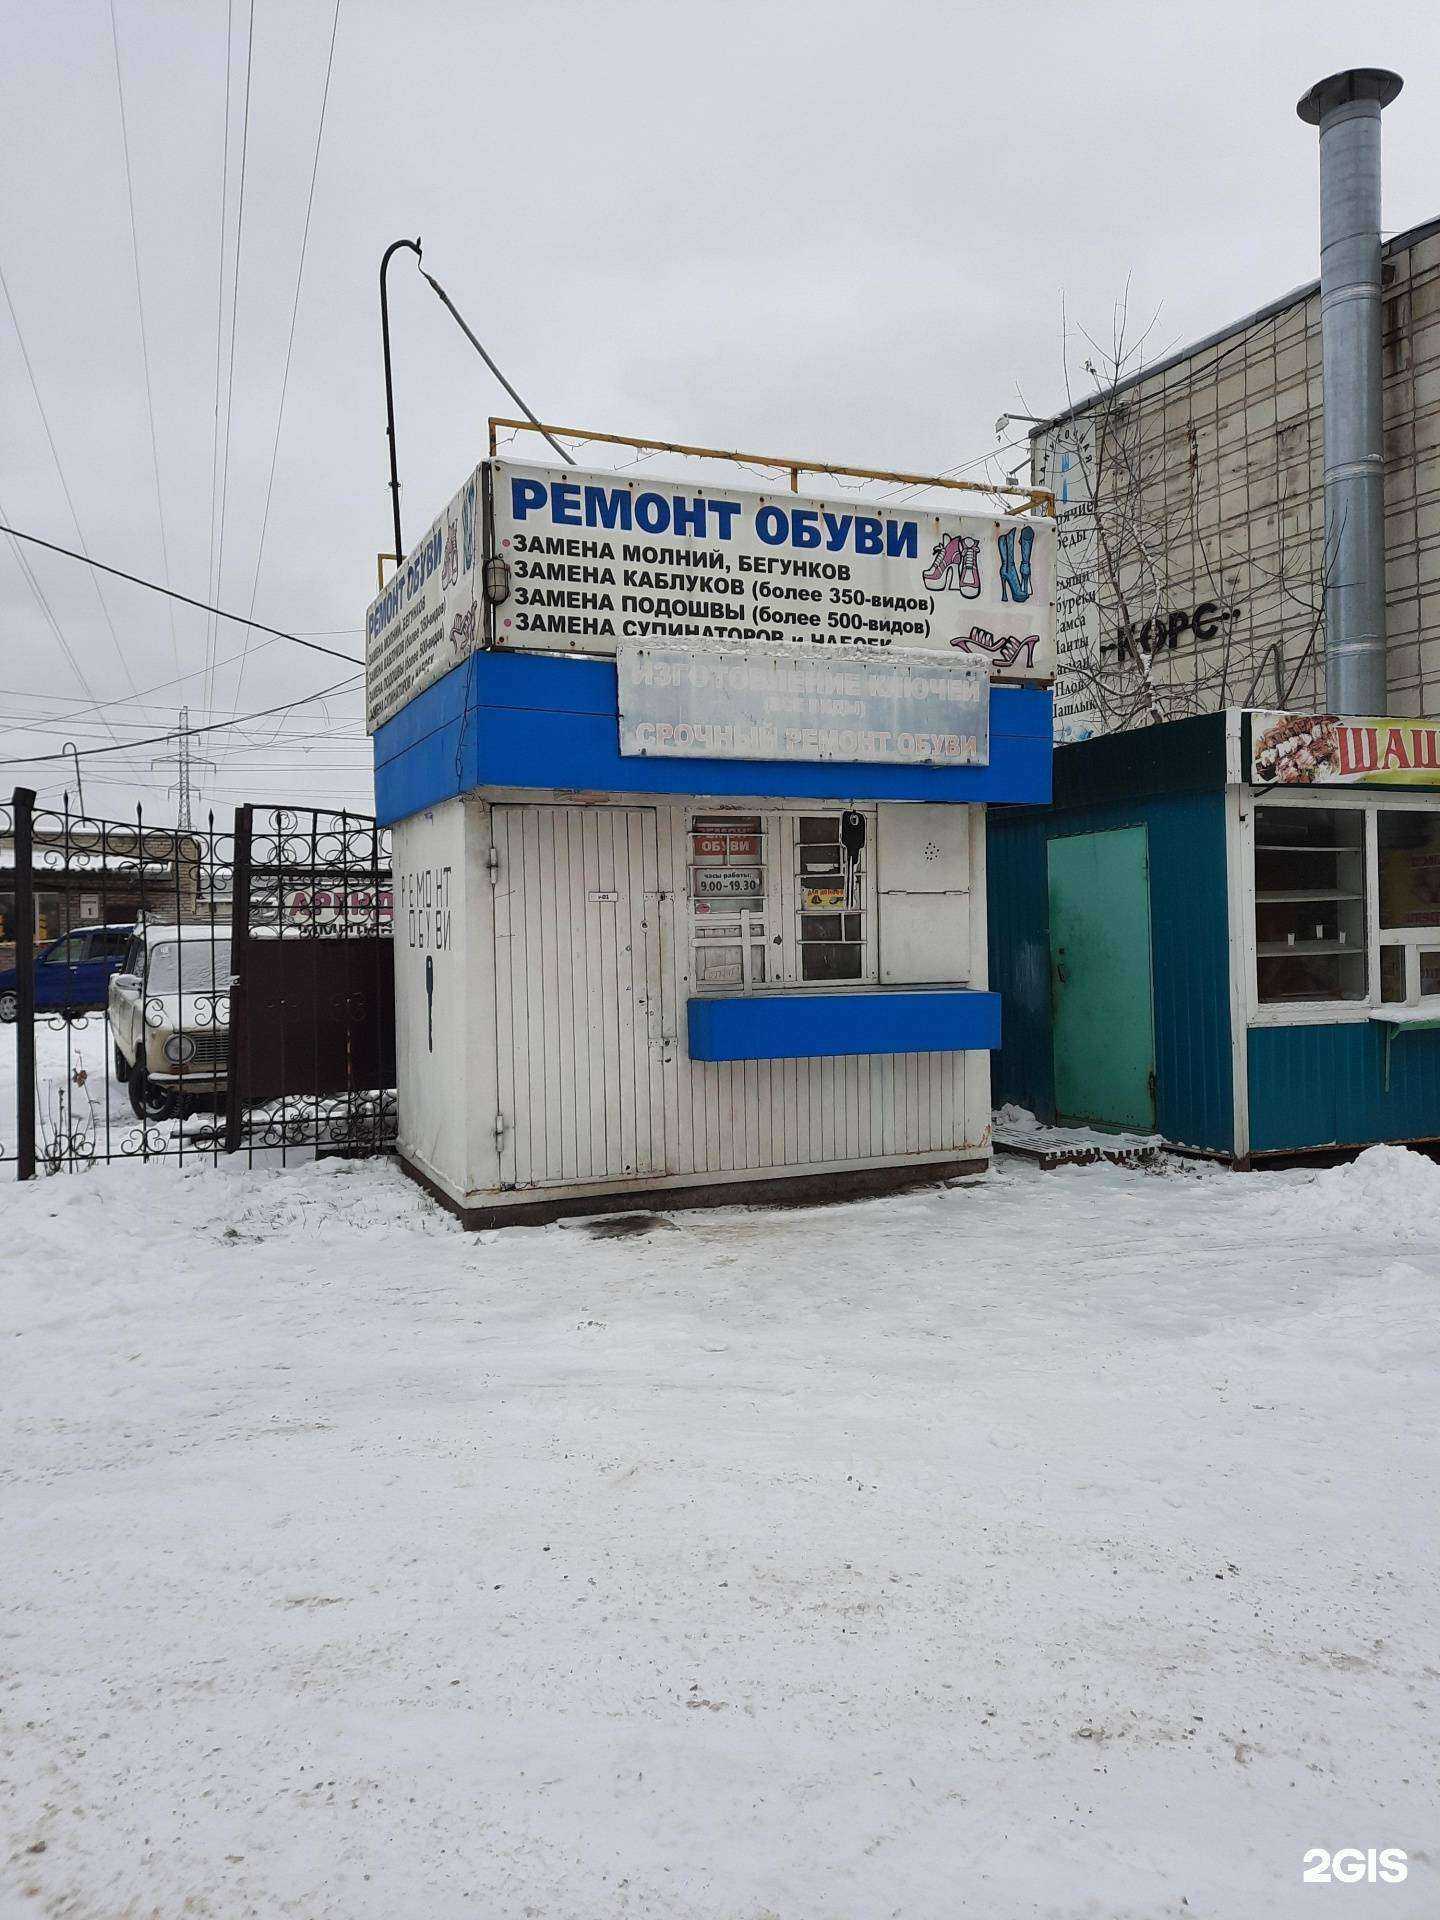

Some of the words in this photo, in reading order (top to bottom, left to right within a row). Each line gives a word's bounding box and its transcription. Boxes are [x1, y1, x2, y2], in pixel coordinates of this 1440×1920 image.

[511, 478, 741, 541] РЕМОНТ
[755, 505, 918, 558] ОБУВИ
[514, 534, 615, 560] ЗАМЕНА
[622, 544, 731, 573] МОЛНИЙ,
[738, 555, 851, 581] БЕГУНКОВ
[368, 574, 405, 645] РЕМОНТ
[407, 527, 442, 601] ОБУВИ
[514, 560, 616, 586] ЗАМЕНА
[623, 569, 745, 595] КАБЛУКОВ
[752, 580, 823, 602] (более
[829, 587, 935, 614] 350-видов)
[514, 587, 615, 611] ЗАМЕНА
[621, 595, 745, 621] ПОДОШВЫ
[752, 605, 823, 627] (более
[827, 611, 931, 638] 500-видов)
[515, 613, 616, 636] ЗАМЕНА
[635, 721, 777, 752] СРОЧНЫЙ
[784, 727, 892, 754] РЕМОНТ
[897, 731, 978, 758] ОБУВИ
[289, 891, 394, 916] АРЕНД
